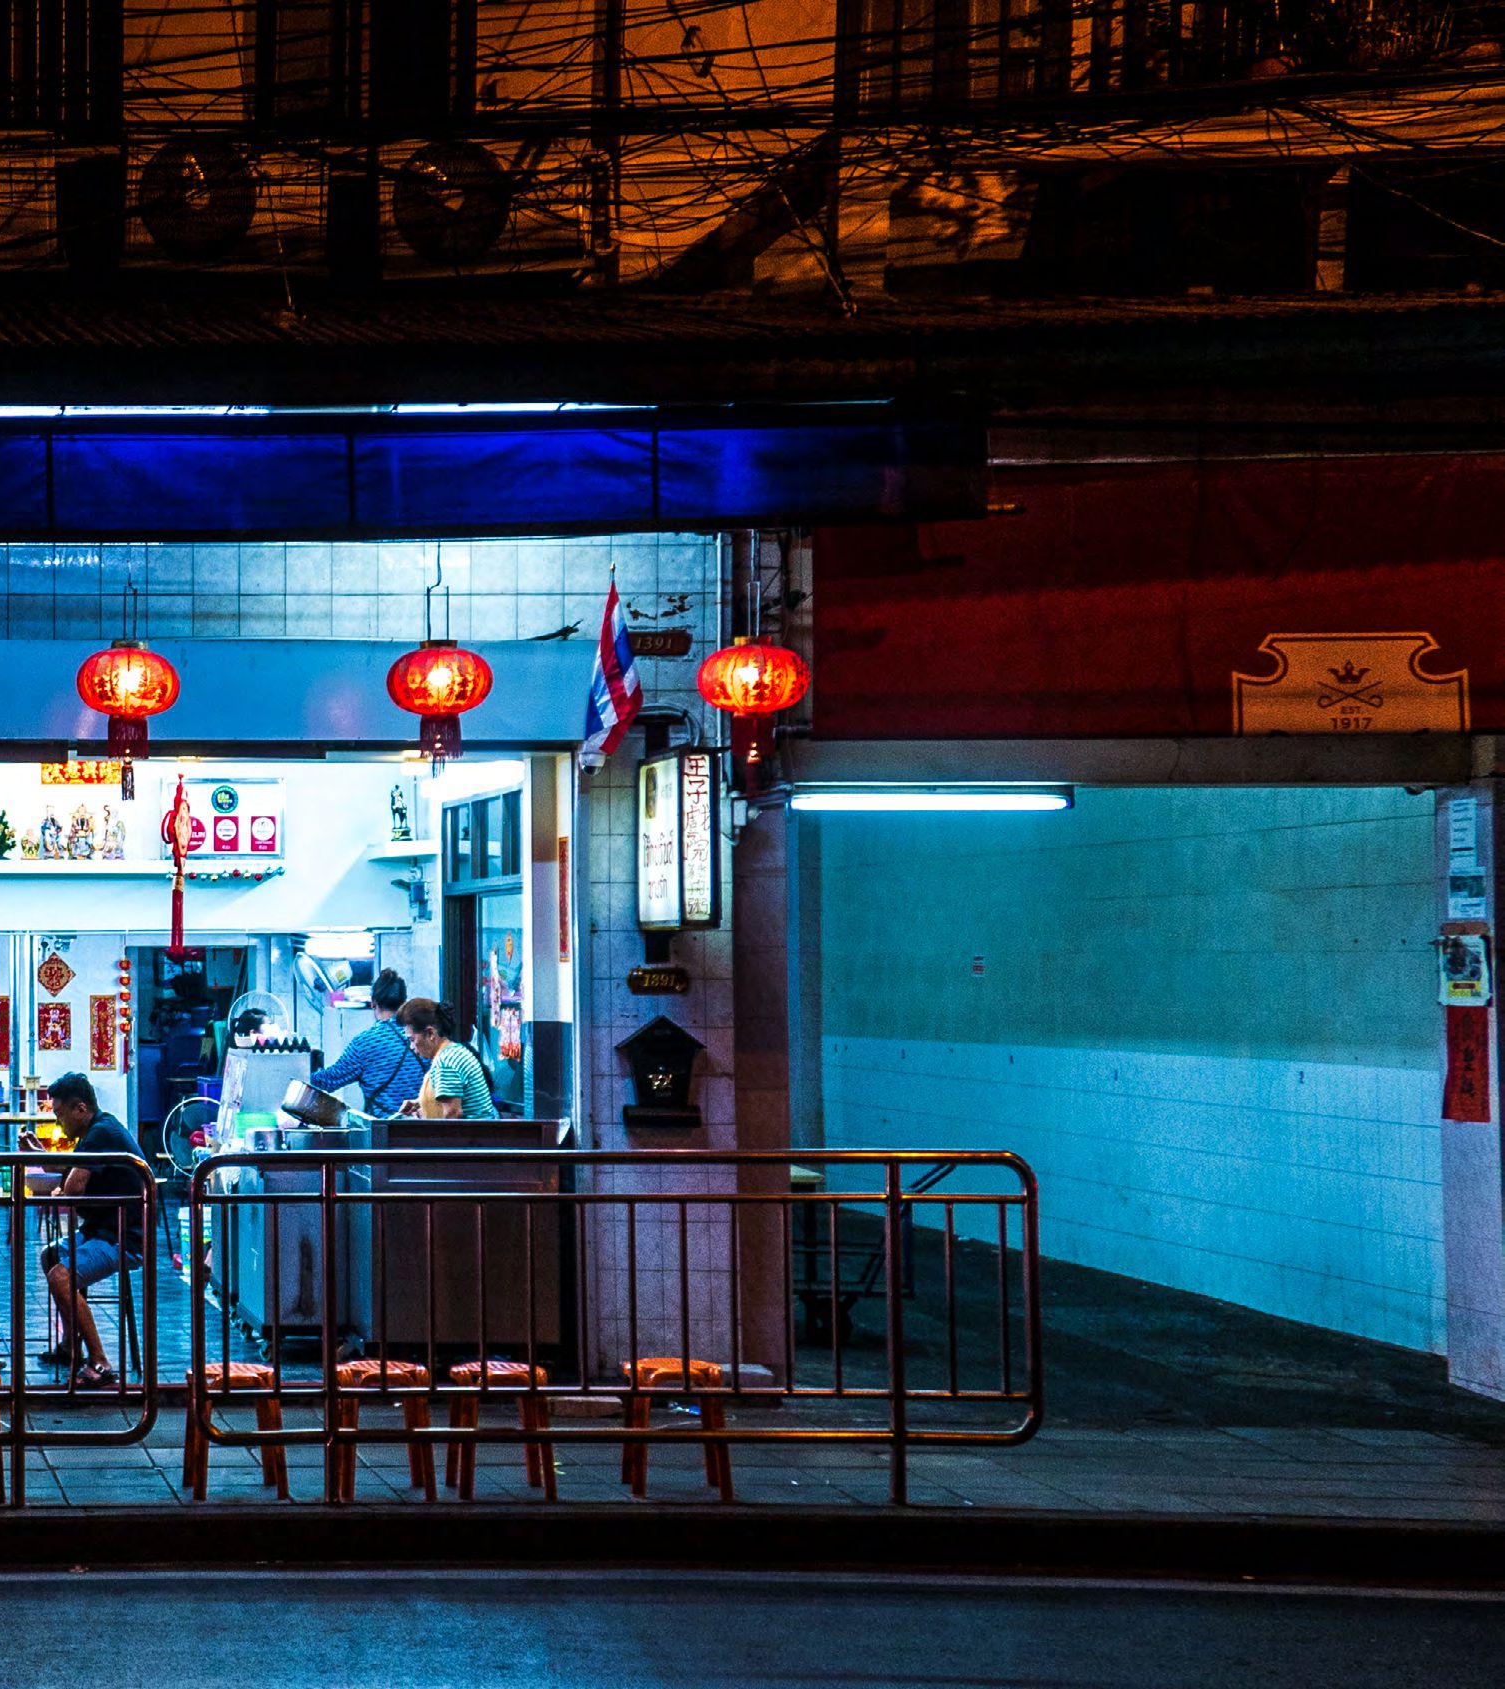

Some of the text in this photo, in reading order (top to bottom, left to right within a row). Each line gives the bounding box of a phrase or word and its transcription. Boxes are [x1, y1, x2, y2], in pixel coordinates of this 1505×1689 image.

[636, 636, 672, 650] 1391
[1330, 717, 1372, 729] 1917
[643, 974, 676, 987] 1391
